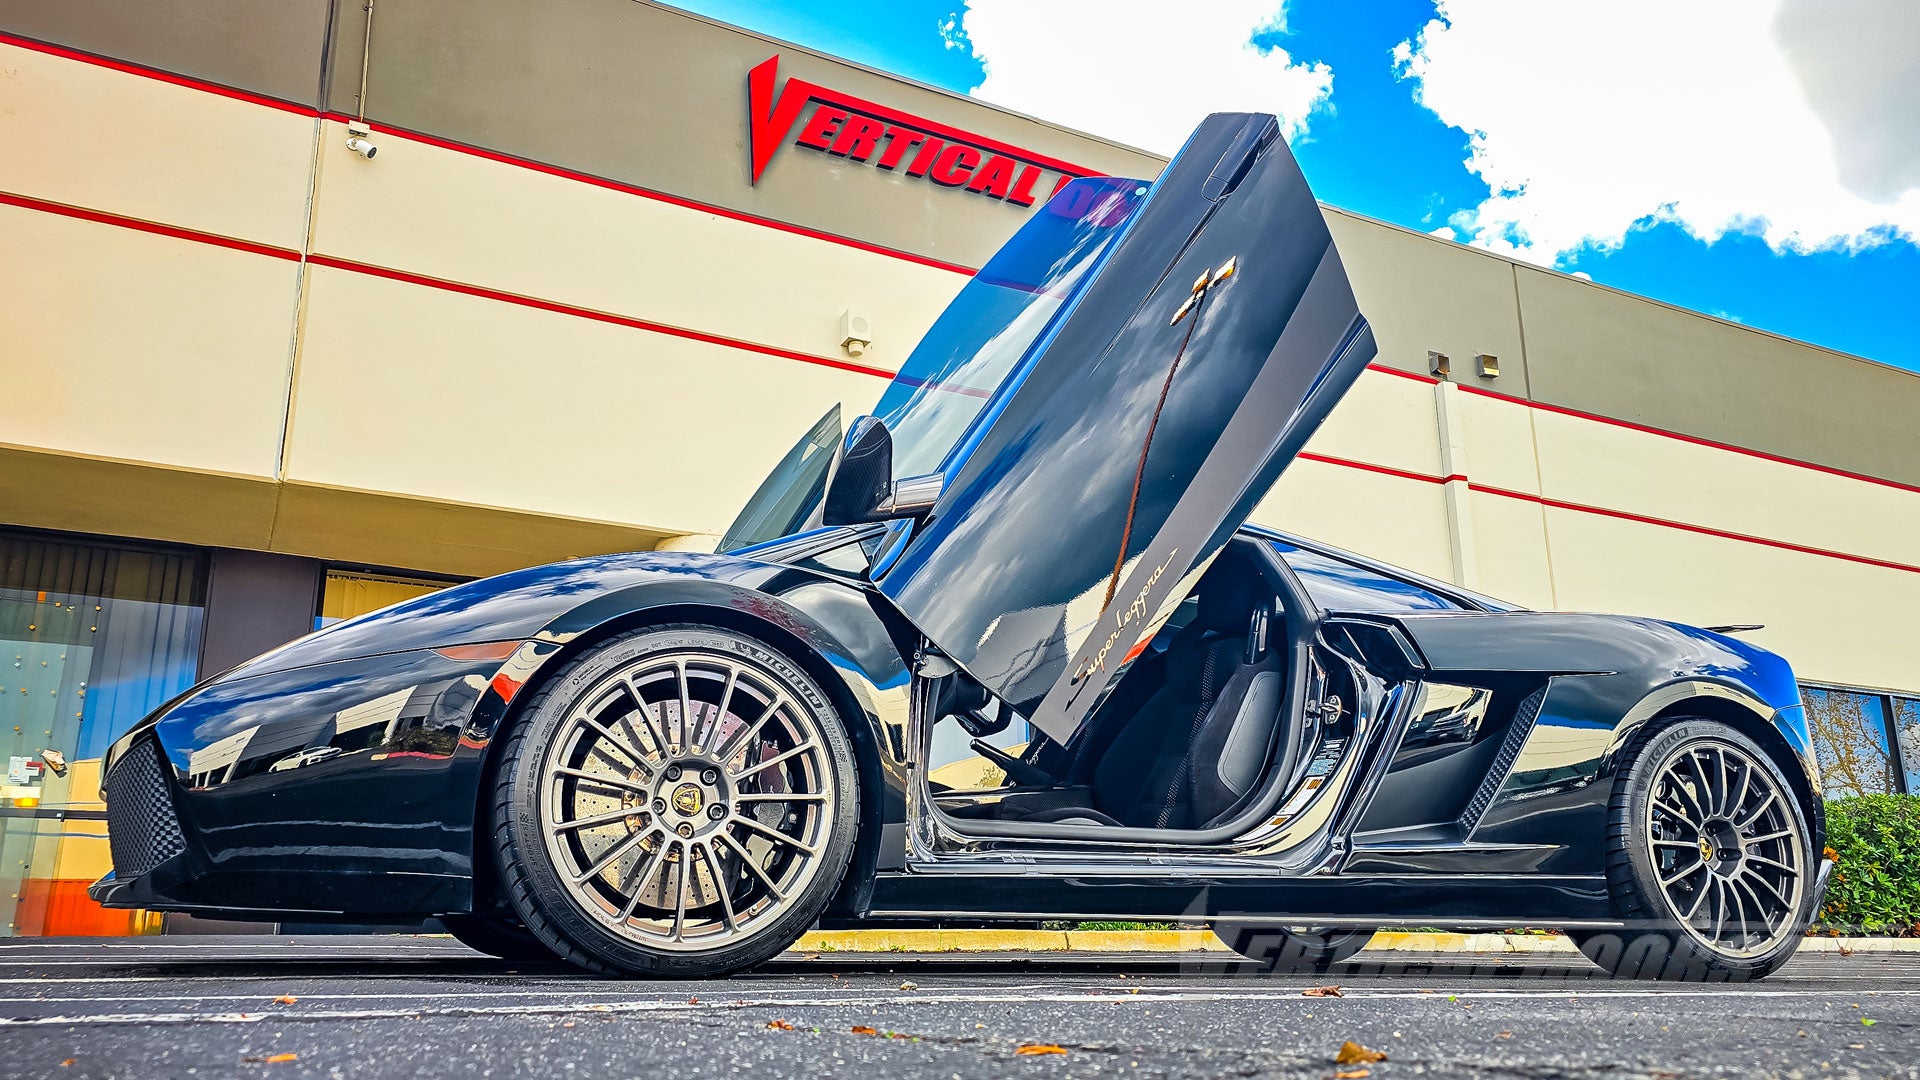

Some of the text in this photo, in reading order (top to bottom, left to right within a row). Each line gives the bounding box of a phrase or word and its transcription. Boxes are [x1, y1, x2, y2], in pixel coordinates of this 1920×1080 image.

[748, 54, 1041, 208] VERTICAL
[755, 651, 822, 706] MICHELIN
[1064, 547, 1178, 712] Superleggera
[1644, 729, 1686, 775] MICHELIN
